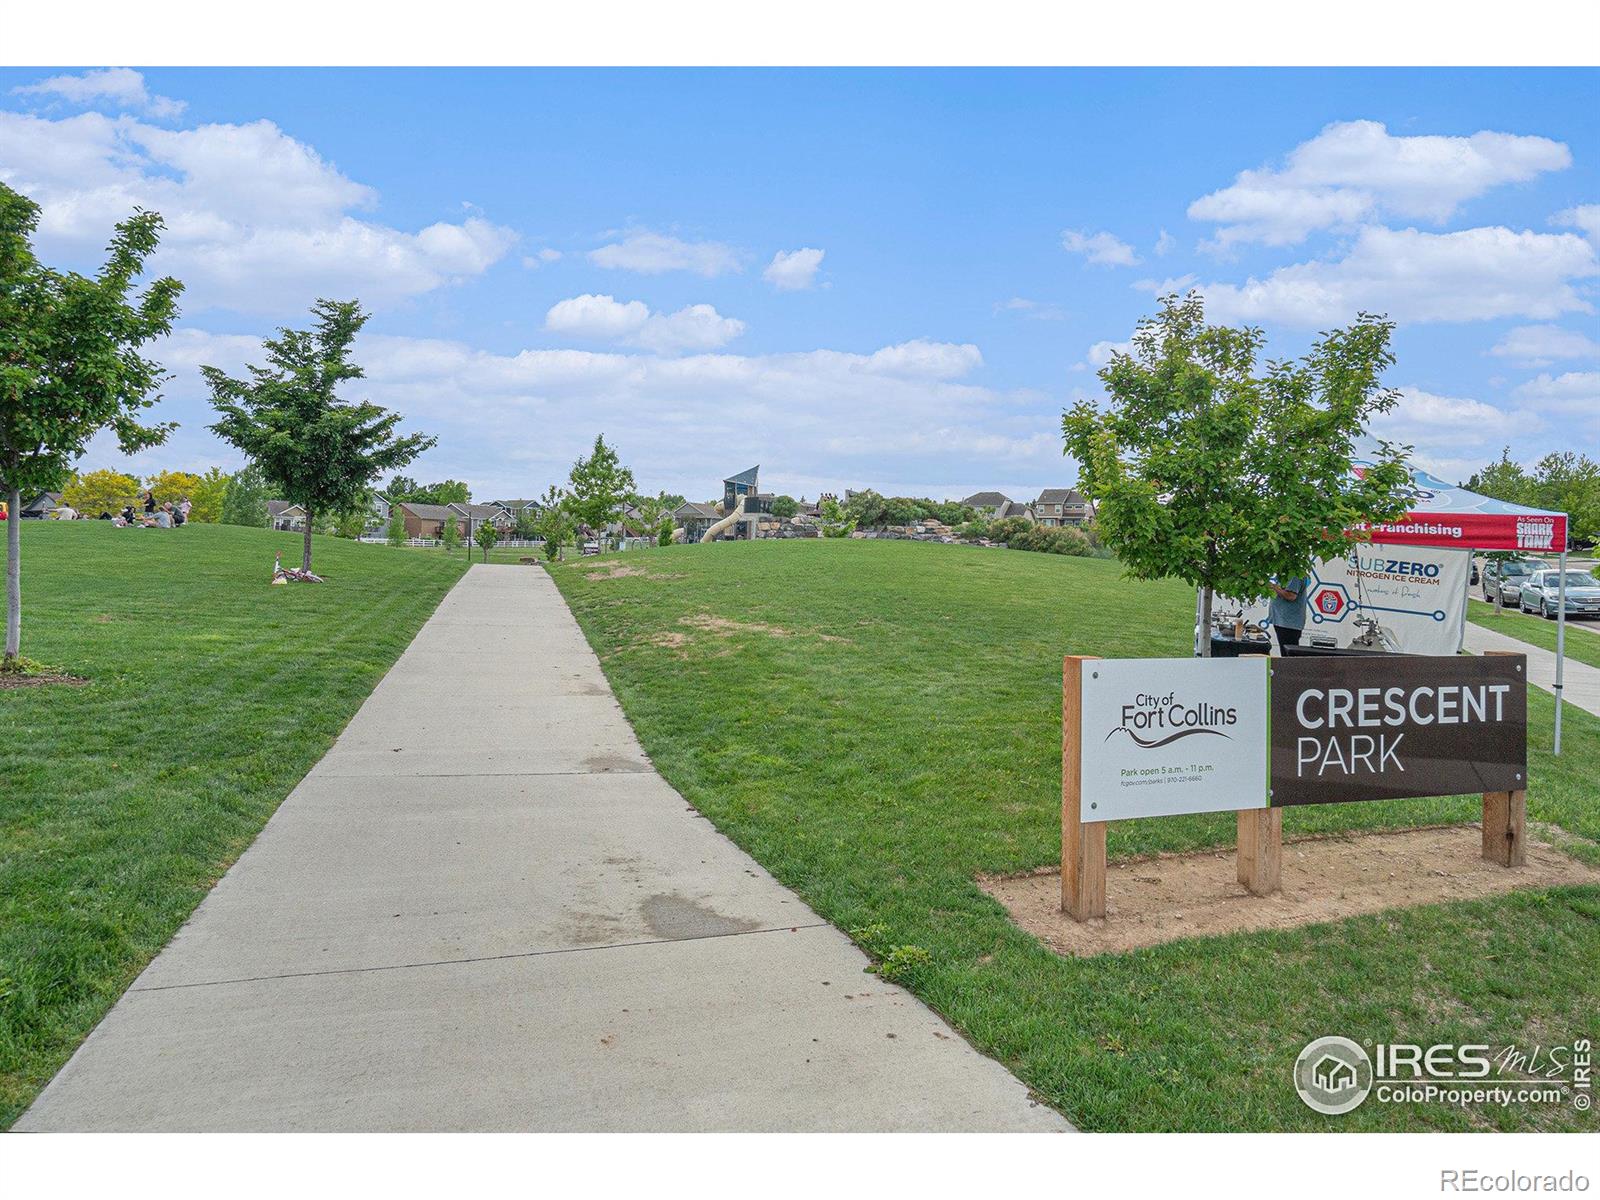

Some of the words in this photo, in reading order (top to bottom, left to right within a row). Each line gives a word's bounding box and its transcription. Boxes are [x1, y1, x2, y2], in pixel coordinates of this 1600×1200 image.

[1516, 522, 1554, 535] SHARK
[1517, 534, 1554, 549] TANK
[1348, 556, 1440, 577] SUBZERO
[1346, 569, 1390, 580] NITROGEN
[1408, 576, 1440, 586] CREAM
[1136, 693, 1160, 709] City
[1161, 692, 1174, 705] of
[1296, 685, 1510, 729] CRESCENT
[1122, 704, 1164, 729] Fort
[1168, 702, 1237, 727] Collins
[1297, 733, 1404, 777] PARK
[1120, 768, 1138, 777] Park
[1139, 767, 1160, 776] open
[1161, 766, 1167, 774] 5
[1168, 766, 1184, 774] a.m.
[1190, 764, 1197, 772] 11
[1198, 764, 1214, 773] p.m.
